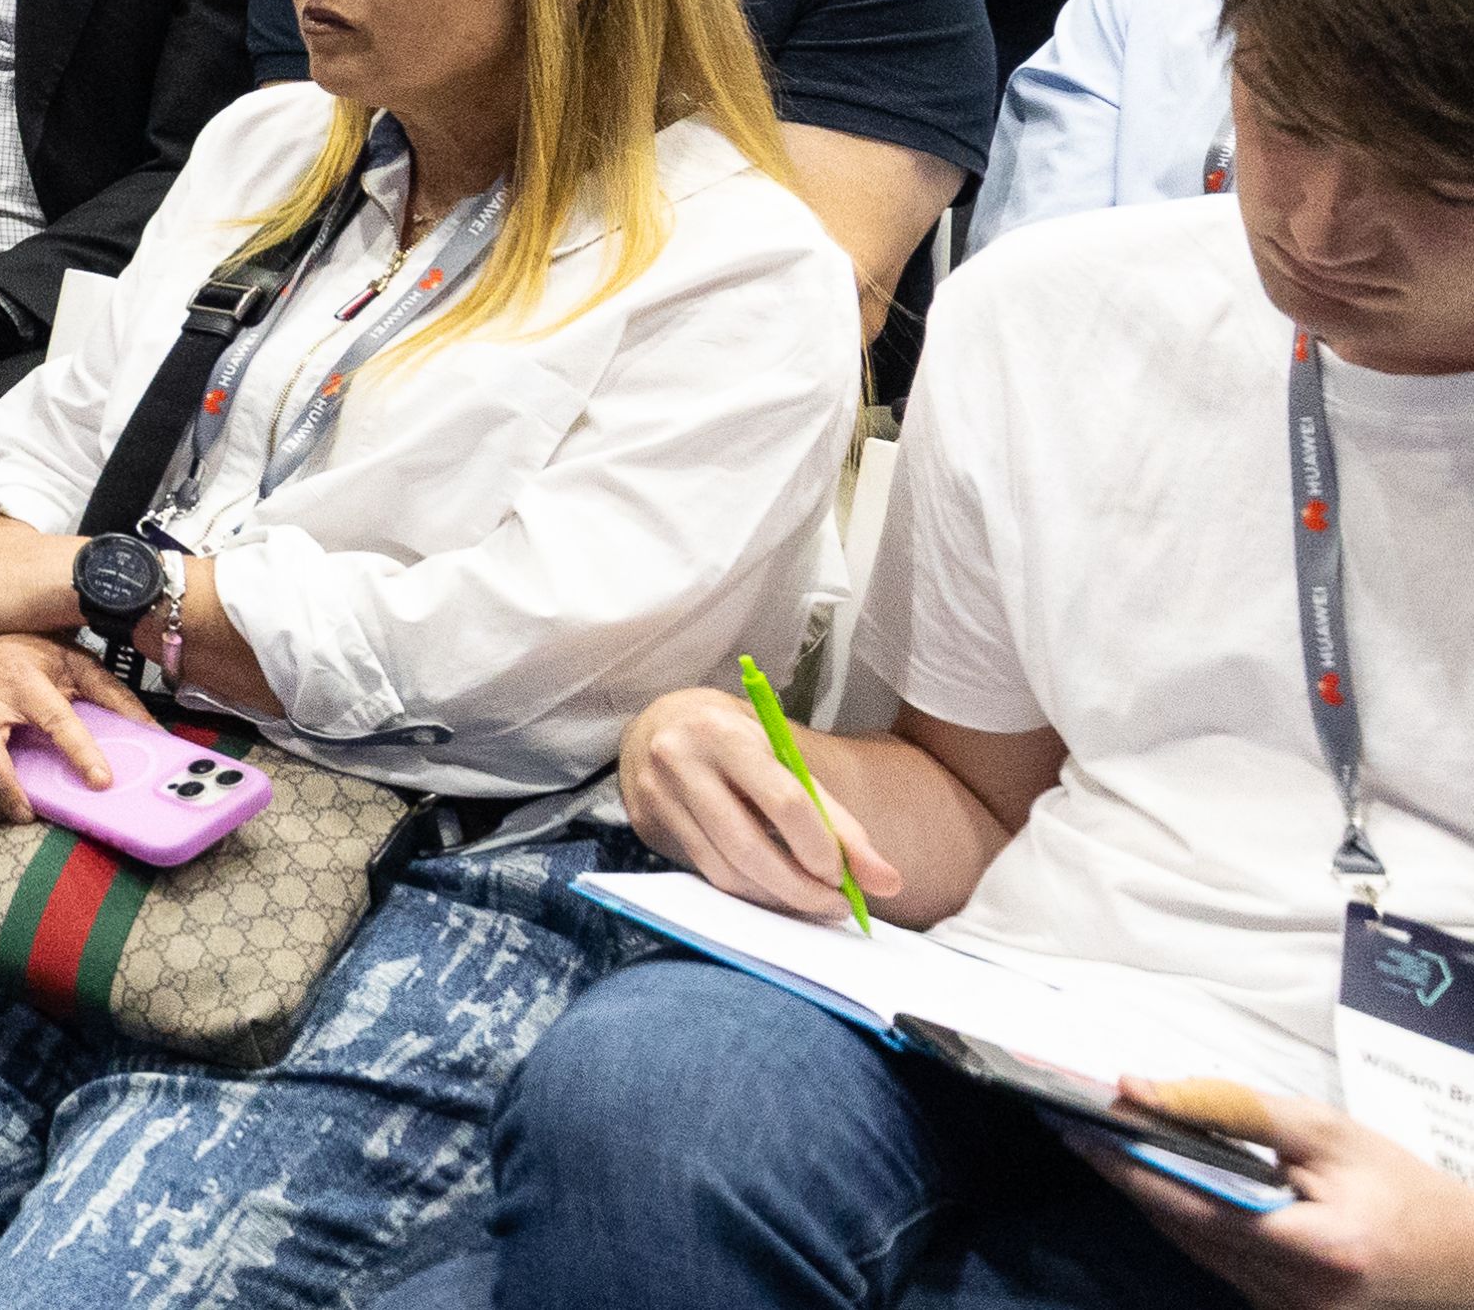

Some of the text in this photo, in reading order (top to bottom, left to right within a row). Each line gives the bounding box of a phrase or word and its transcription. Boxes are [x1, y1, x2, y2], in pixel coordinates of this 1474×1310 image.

[467, 184, 510, 237] UAWEI
[371, 289, 422, 340] HUAWEI
[218, 329, 260, 388] HUAWEI
[280, 396, 328, 453] HUAWEI
[1299, 415, 1323, 496] HUAWEI
[1312, 585, 1335, 667] HUAWEI
